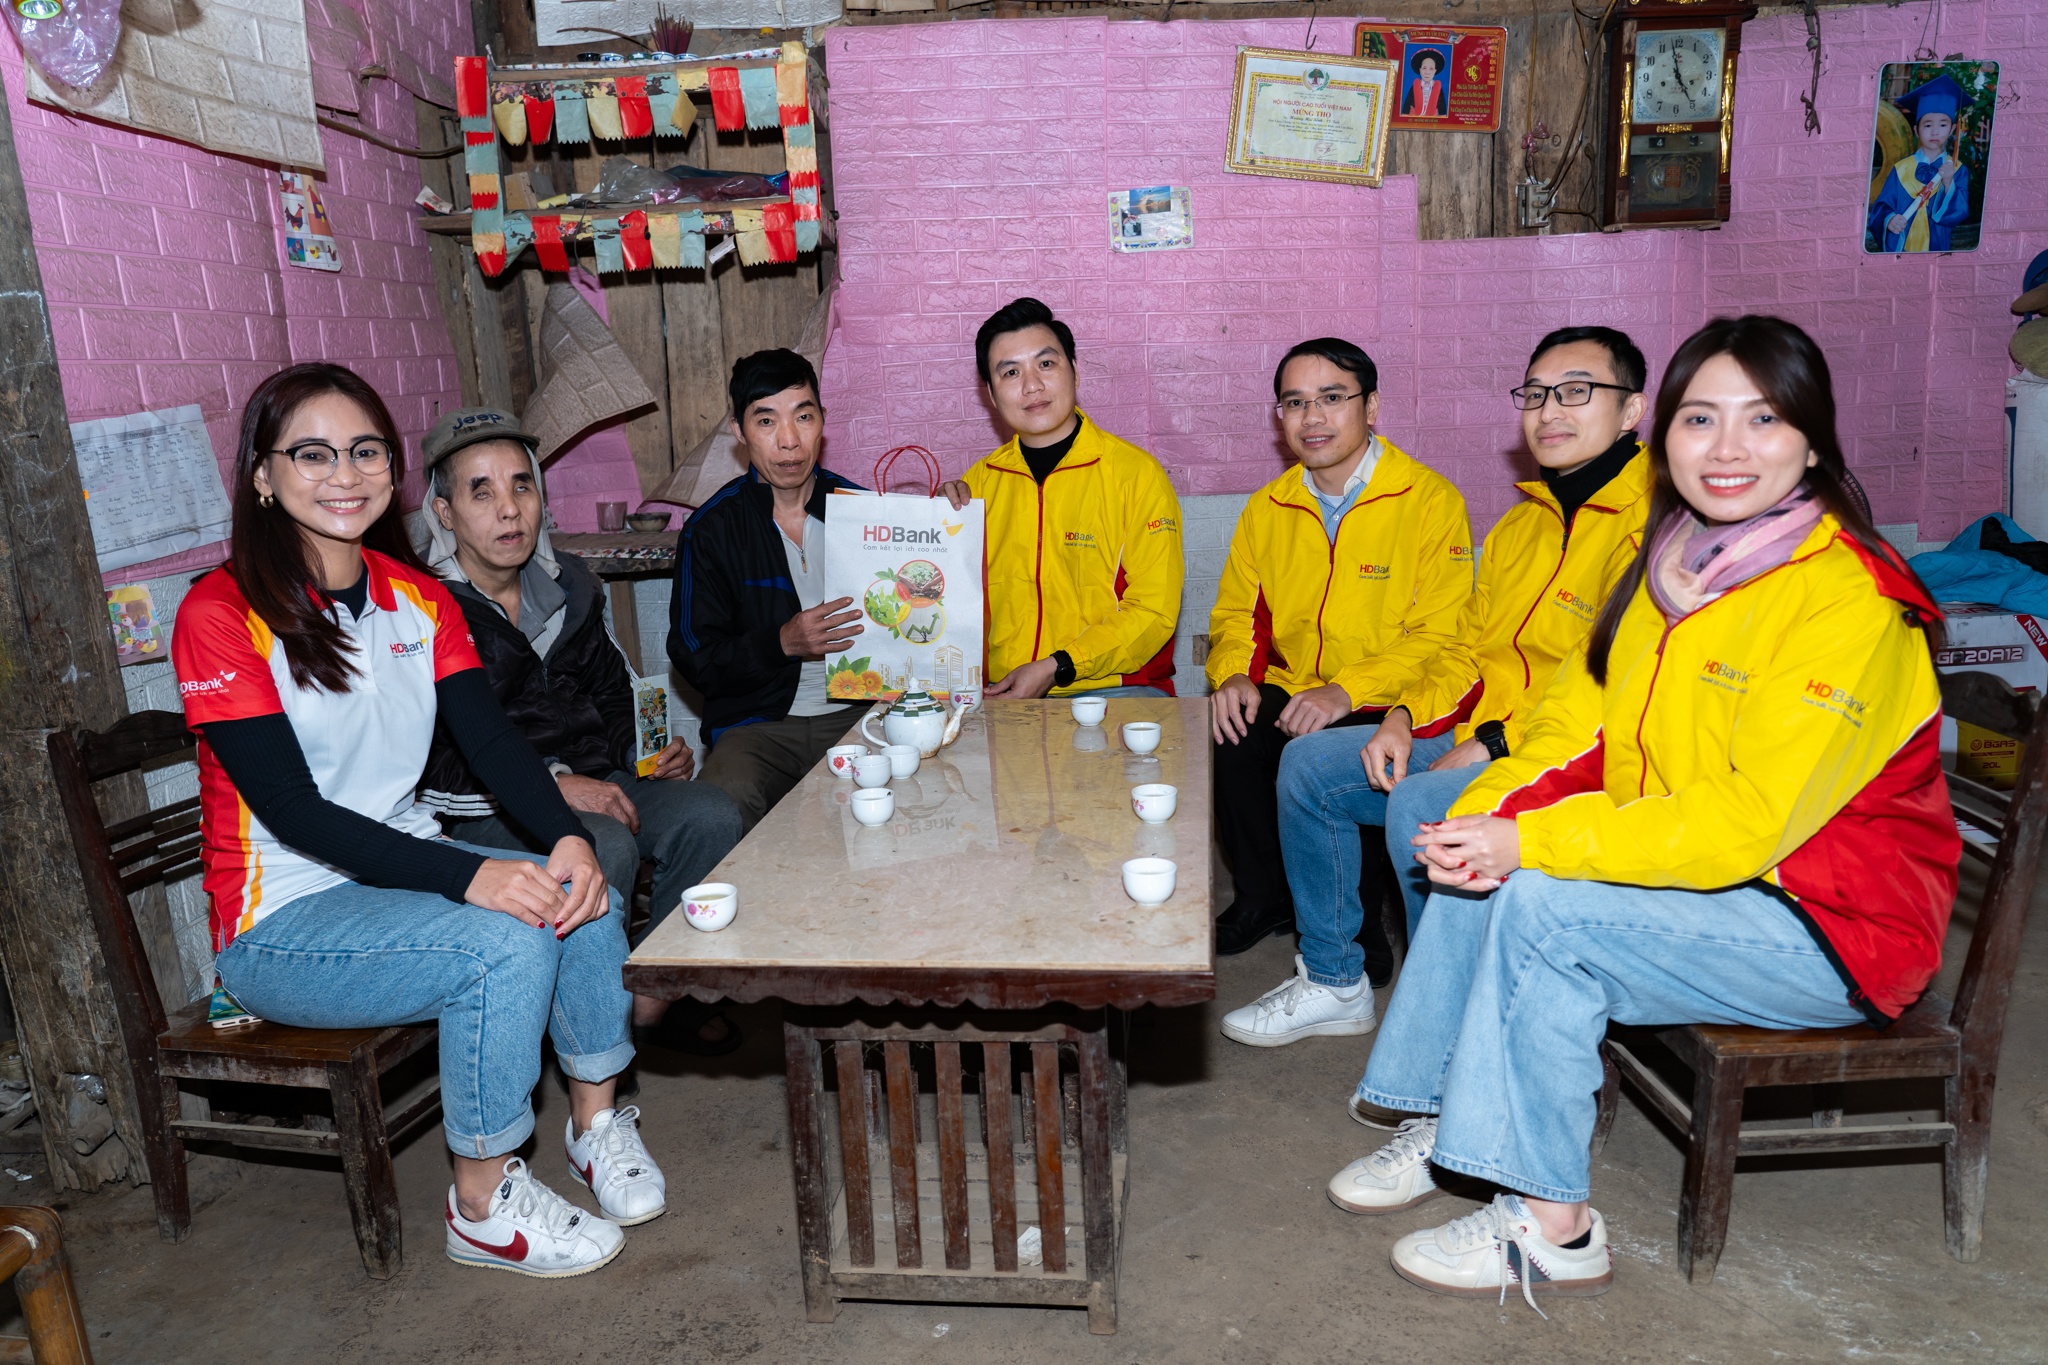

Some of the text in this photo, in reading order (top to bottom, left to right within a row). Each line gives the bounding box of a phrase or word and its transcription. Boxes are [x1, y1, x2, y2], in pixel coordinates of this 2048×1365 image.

[1675, 38, 1684, 48] 12
[1693, 42, 1697, 52] 1
[1659, 44, 1666, 53] 11
[1647, 56, 1655, 66] 10
[1703, 54, 1709, 64] 2
[1643, 73, 1649, 82] 9
[1706, 71, 1712, 80] 3
[1646, 89, 1652, 99] 8
[1701, 87, 1707, 97] 4
[1656, 101, 1663, 110] 7
[1673, 105, 1679, 114] 6
[1690, 100, 1696, 109] 5
[452, 414, 502, 430] Jeep
[863, 525, 942, 544] HDBank
[1065, 532, 1094, 542] HDBank
[1556, 588, 1594, 615] HDBank
[2024, 619, 2047, 647] NEW
[389, 641, 424, 654] HDBan
[1702, 659, 1750, 684] HDBank
[180, 678, 224, 694] DBank
[1805, 679, 1866, 716] HDBank
[1984, 740, 2016, 749] BGAS
